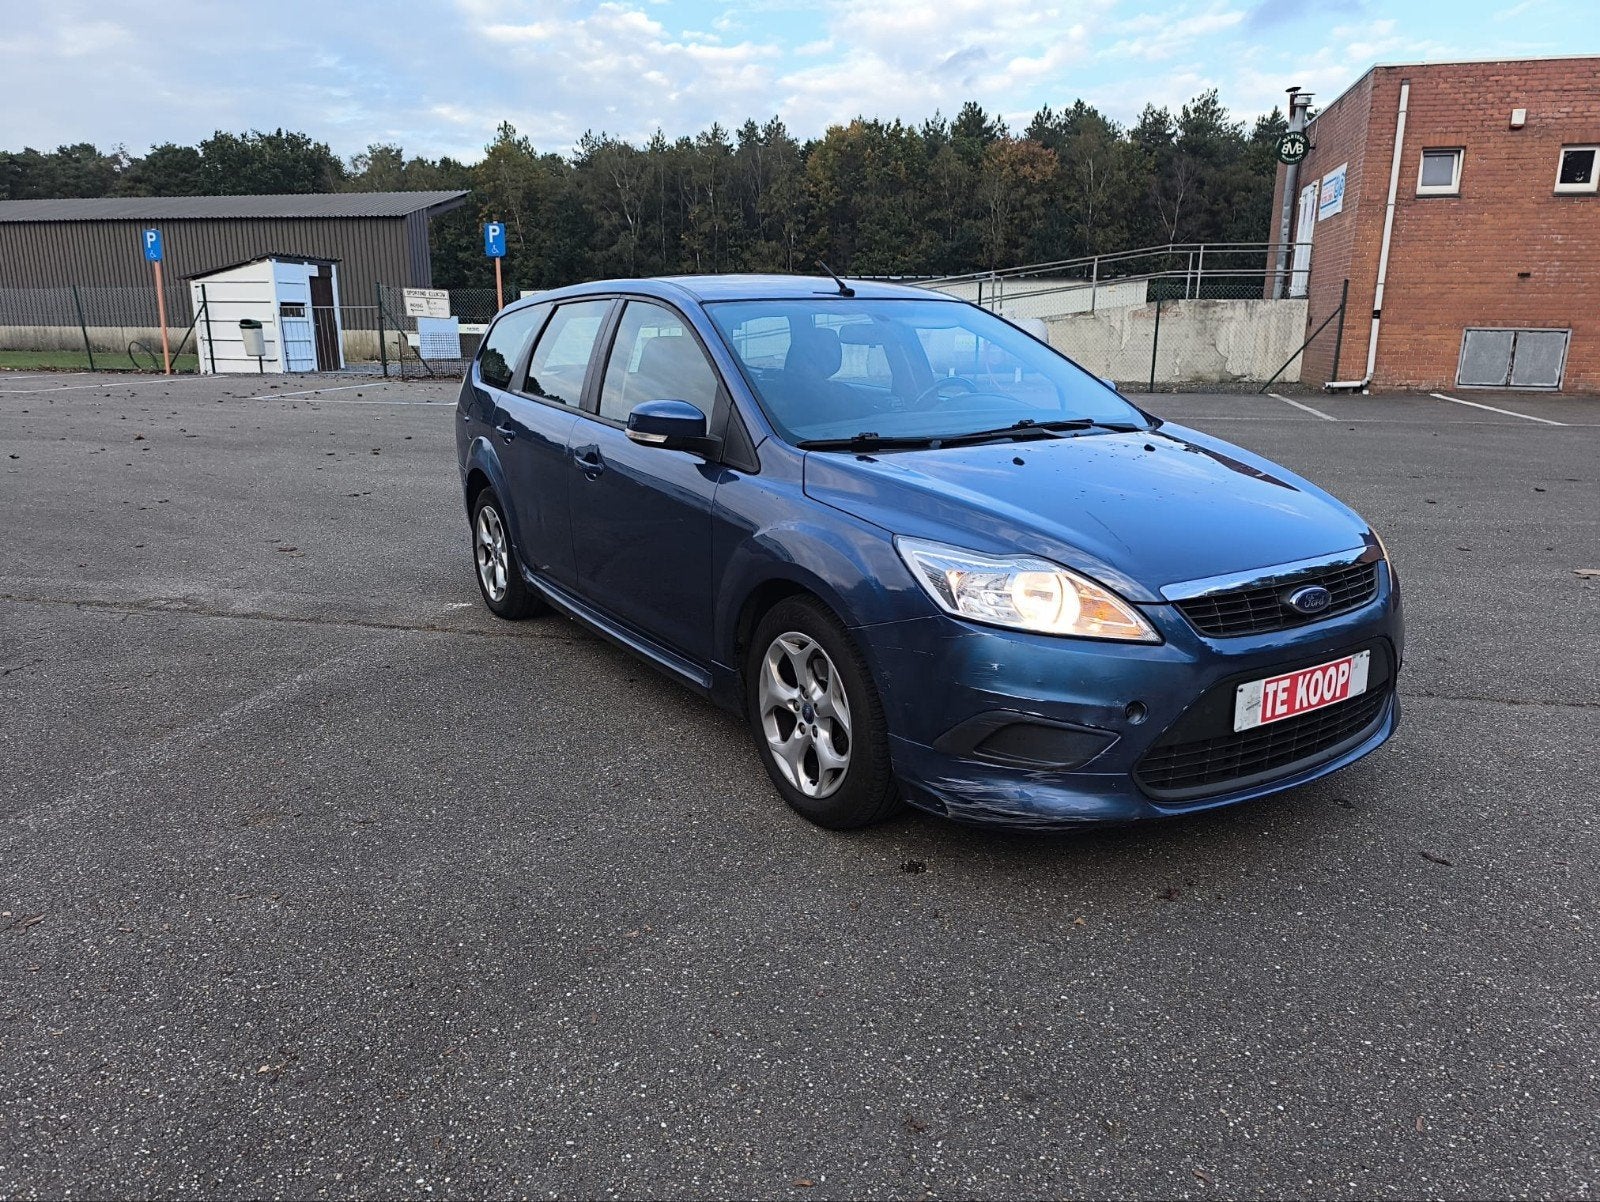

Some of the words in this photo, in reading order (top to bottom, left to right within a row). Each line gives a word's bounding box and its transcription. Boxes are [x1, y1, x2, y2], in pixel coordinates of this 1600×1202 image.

[1281, 142, 1304, 154] BVB
[147, 232, 156, 248] P
[489, 225, 500, 243] P
[1304, 593, 1324, 607] Ford
[1265, 679, 1290, 718] TE
[1295, 662, 1350, 710] KOOP
